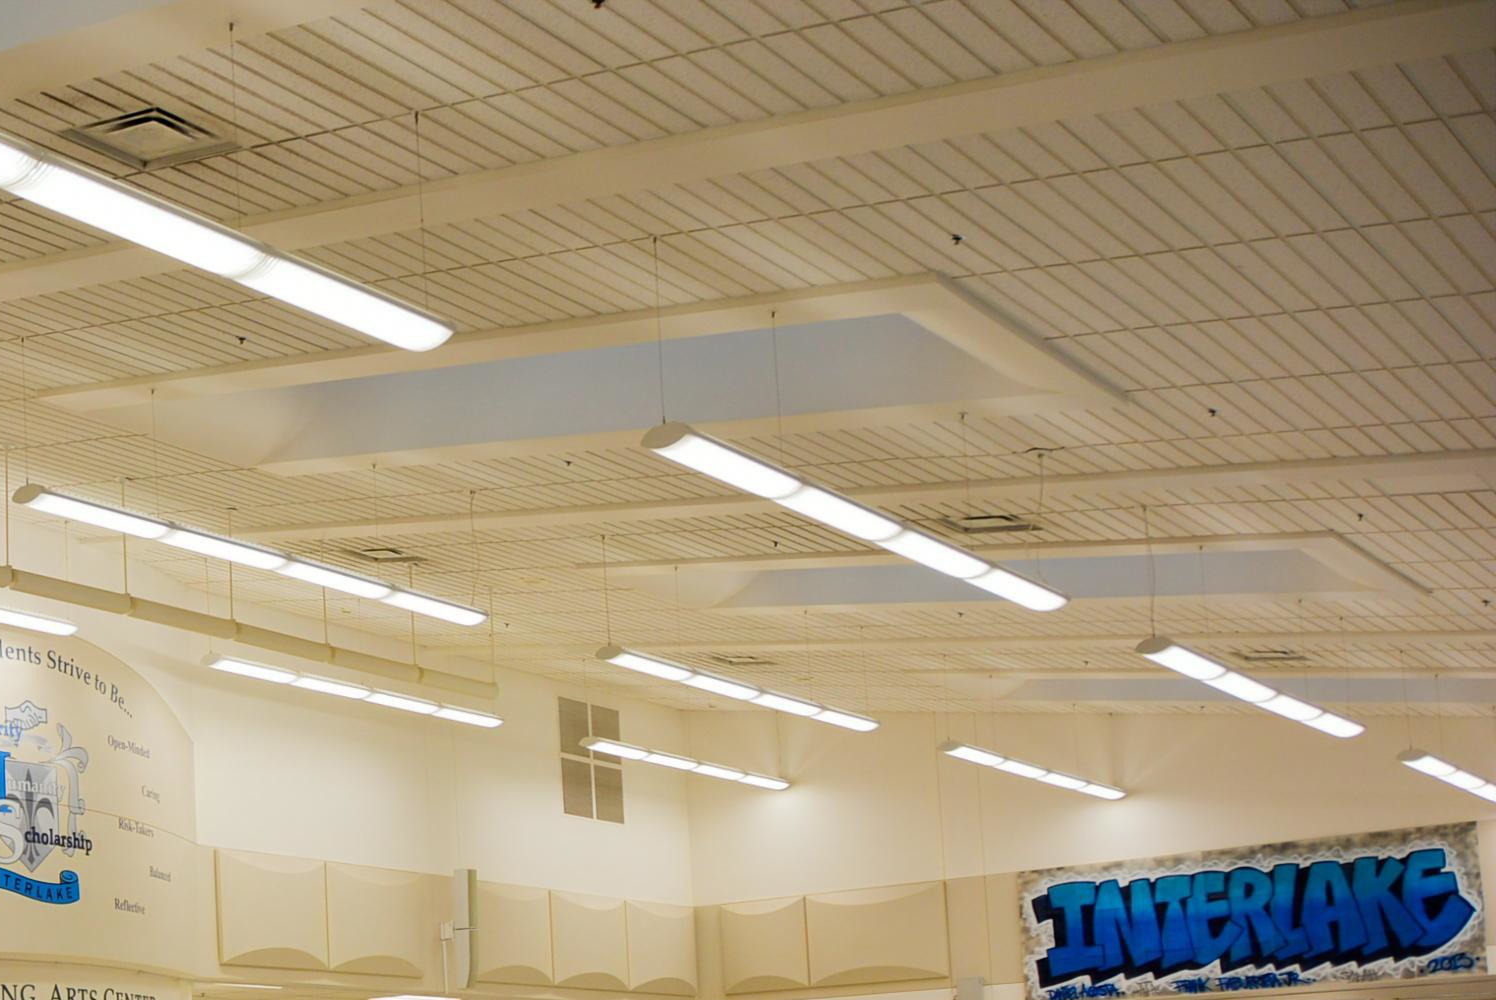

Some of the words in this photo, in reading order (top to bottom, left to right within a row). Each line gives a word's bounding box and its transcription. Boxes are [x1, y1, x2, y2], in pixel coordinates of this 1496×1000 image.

[46, 650, 91, 685] Strive
[94, 673, 107, 693] to
[107, 735, 151, 760] Open-Minded
[117, 817, 155, 839] Risk-Takers
[113, 897, 146, 916] Reflective
[1034, 848, 1476, 986] INTERLAKE
